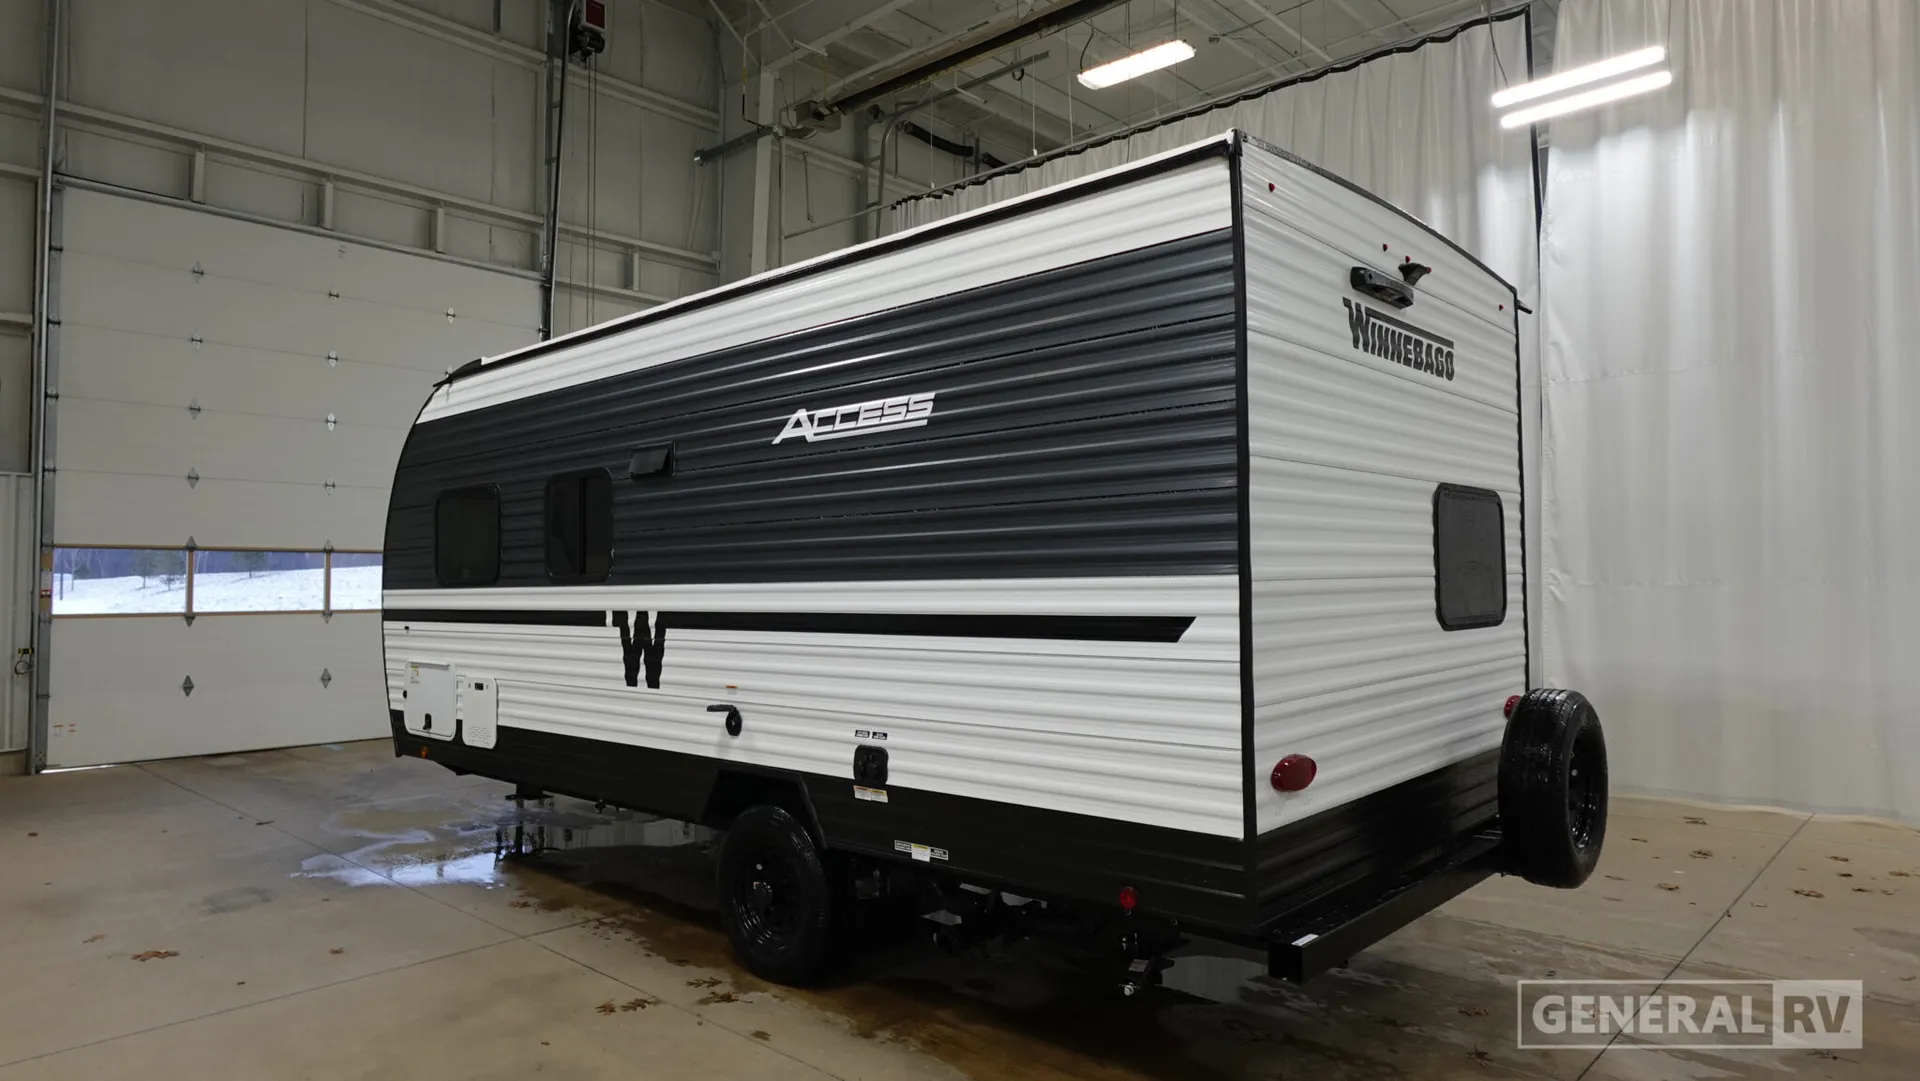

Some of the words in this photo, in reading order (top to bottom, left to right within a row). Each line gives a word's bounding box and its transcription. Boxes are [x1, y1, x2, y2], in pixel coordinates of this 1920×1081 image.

[1342, 296, 1455, 382] WINNEBAGO
[771, 392, 936, 445] ACCESS
[611, 610, 667, 690] W
